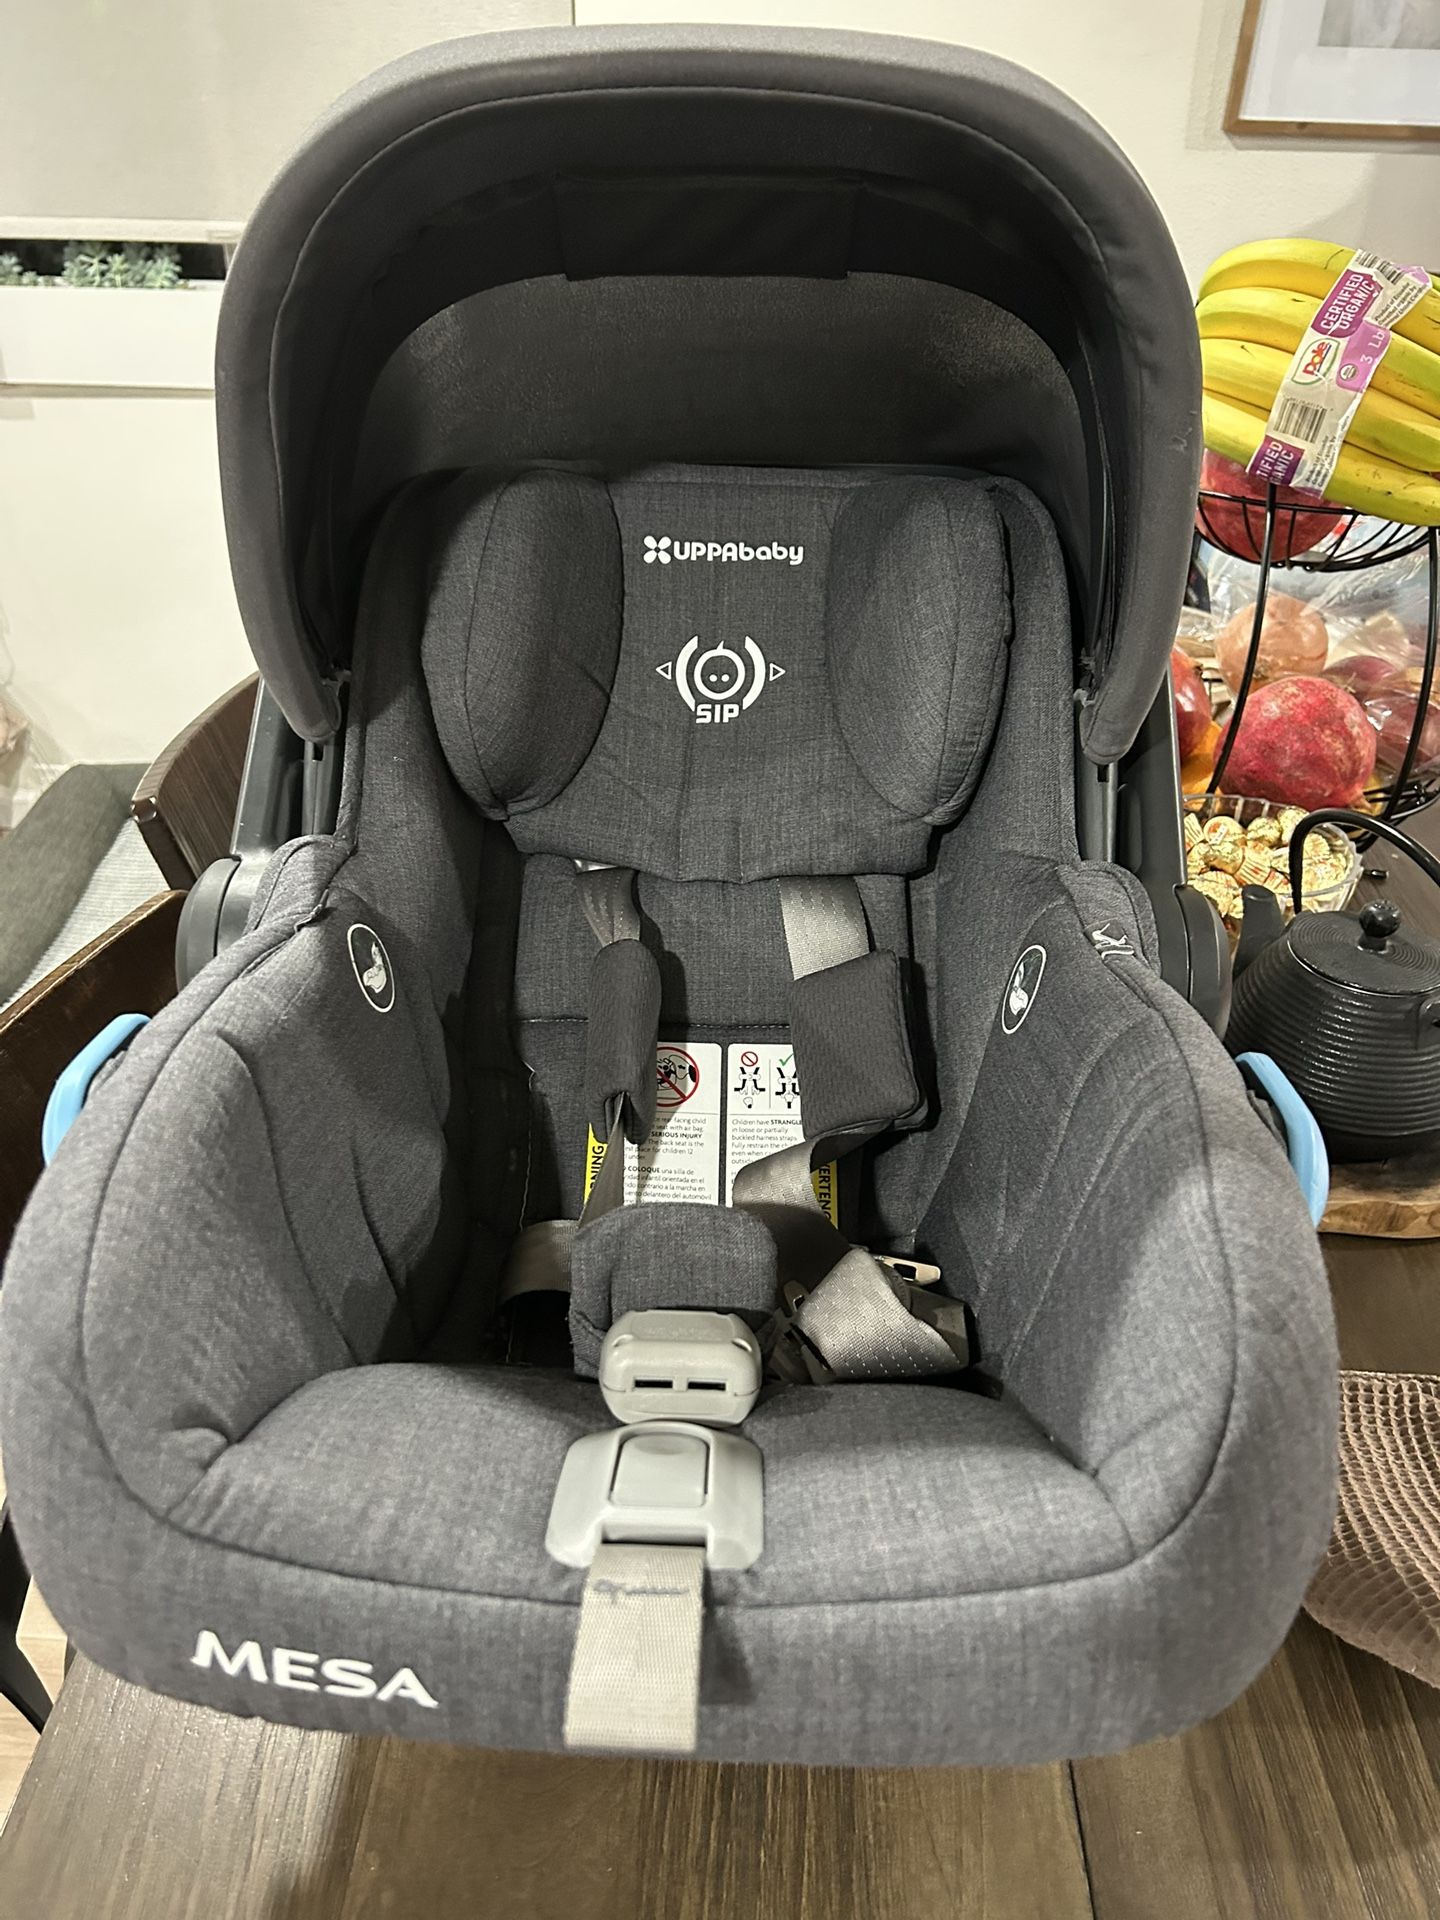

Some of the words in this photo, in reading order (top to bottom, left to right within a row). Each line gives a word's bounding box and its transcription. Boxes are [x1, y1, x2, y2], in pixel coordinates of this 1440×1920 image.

[1320, 273, 1364, 330] CERTIFIED
[1339, 280, 1375, 330] ORGANIC
[1302, 341, 1328, 375] Dole
[1360, 354, 1373, 364] 3
[1368, 331, 1385, 349] Lb
[1256, 441, 1283, 480] TIFIED
[673, 541, 804, 566] UPPAbaby
[696, 703, 740, 724] SIP
[628, 1165, 660, 1174] COLOQUE
[661, 1175, 691, 1184] orientada
[637, 1182, 664, 1190] contrario
[642, 1190, 671, 1199] delantero
[190, 1629, 440, 1709] MESA
